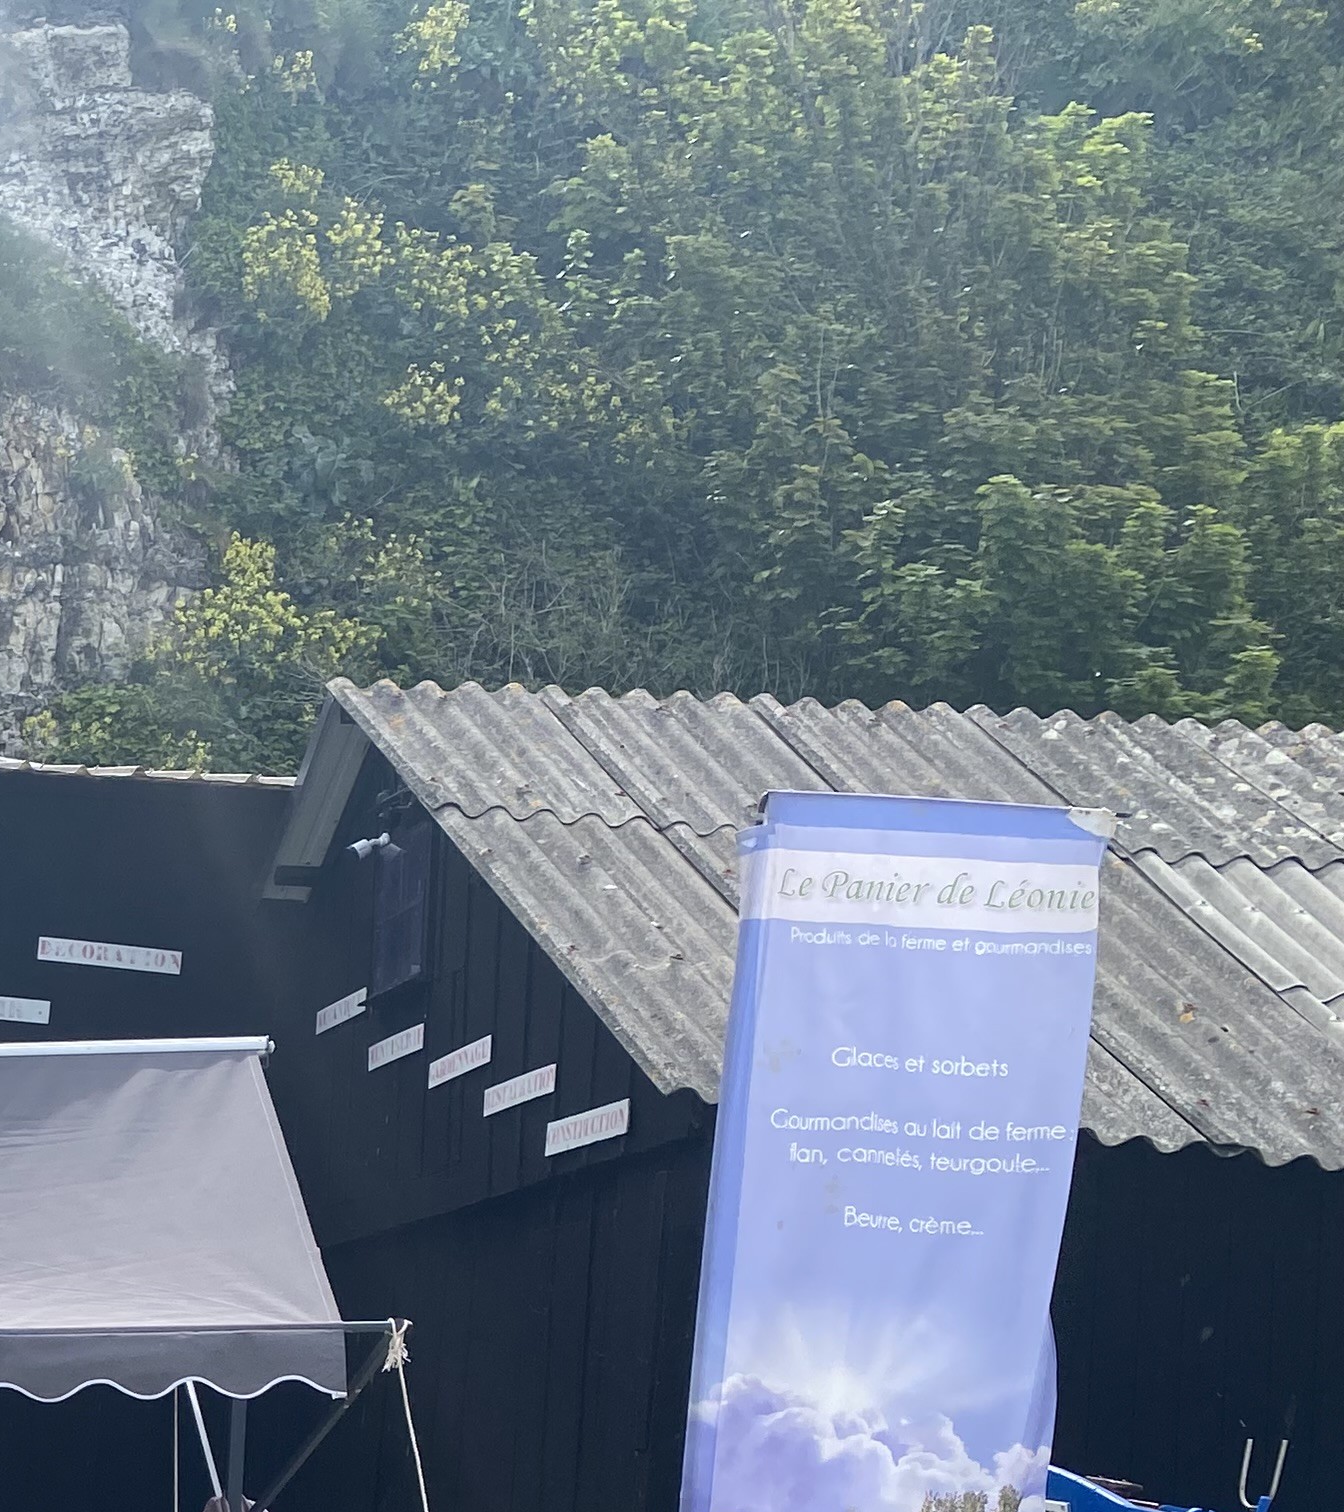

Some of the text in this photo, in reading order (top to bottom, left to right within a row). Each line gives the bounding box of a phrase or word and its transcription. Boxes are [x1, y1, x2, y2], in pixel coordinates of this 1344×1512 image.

[777, 868, 1096, 910] Le Panier de Léonie
[791, 926, 1092, 955] Produits de la ferme et gourmandises
[831, 1046, 1009, 1077] Glaces et sorbets
[770, 1107, 898, 1135] Gourmandises
[904, 1120, 926, 1137] au
[932, 1119, 961, 1140] lait
[969, 1121, 999, 1142] de
[843, 1206, 903, 1233] Beurre,
